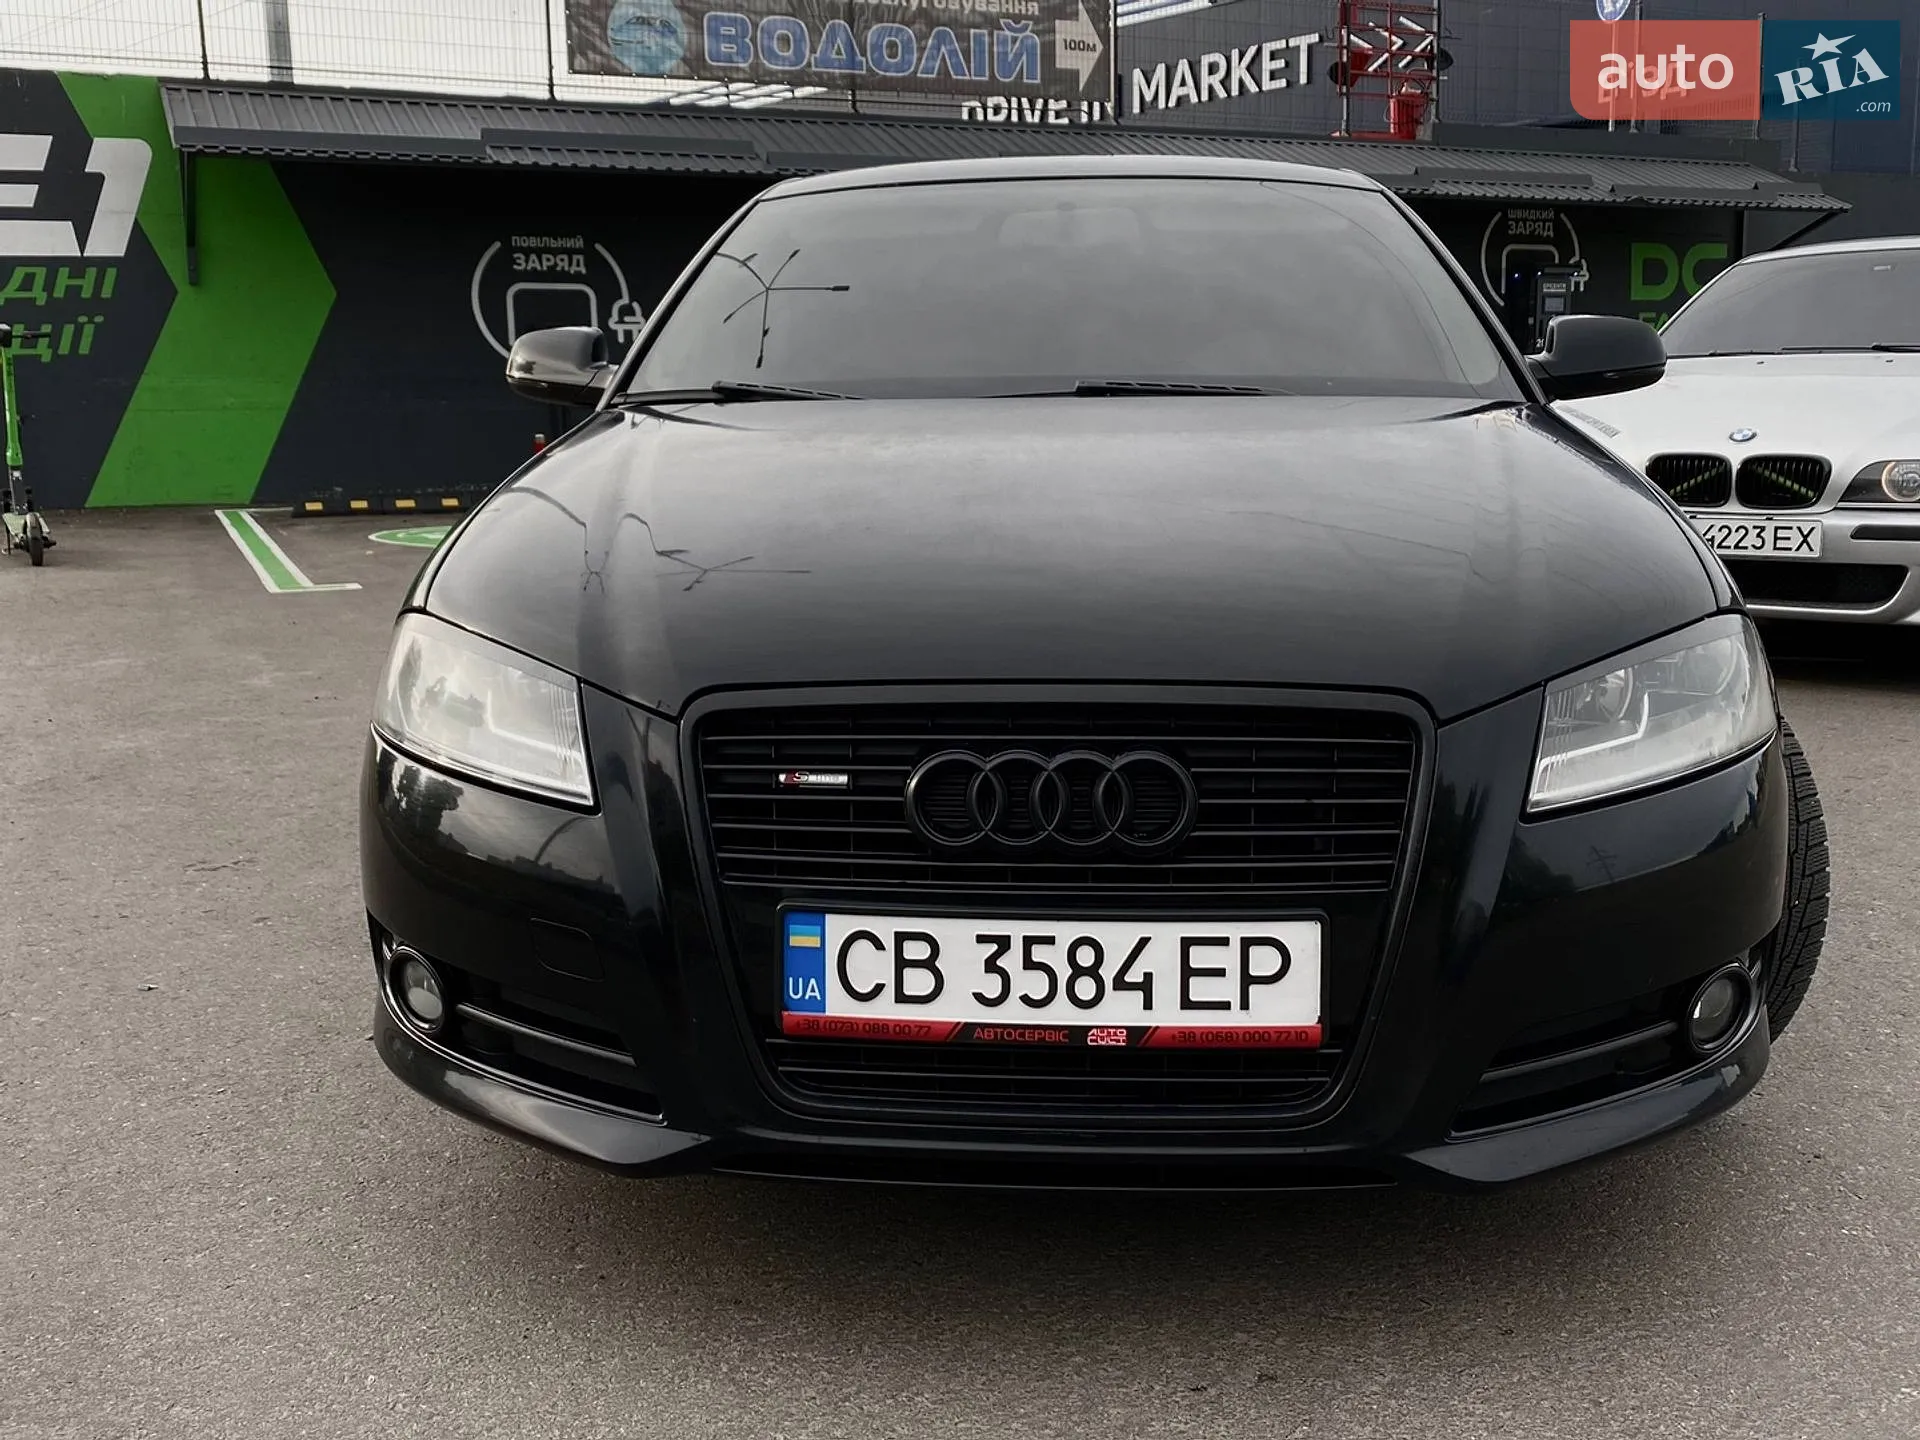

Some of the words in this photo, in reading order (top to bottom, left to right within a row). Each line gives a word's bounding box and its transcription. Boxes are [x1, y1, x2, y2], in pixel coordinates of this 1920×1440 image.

[703, 12, 1041, 84] ВОДОЛІЙ
[1132, 32, 1320, 114] MARKET
[1507, 219, 1555, 238] ЗАРЯД
[511, 235, 584, 249] ПОВІЛЬНИЙ
[512, 252, 587, 275] ЗАРЯД
[1703, 524, 1766, 551] 4223
[1772, 526, 1816, 552] EX
[836, 929, 945, 1005] CB
[971, 934, 1154, 1010] 3584
[1179, 935, 1293, 1011] EP
[788, 976, 822, 1001] UA
[973, 1027, 1070, 1042] АВТОСЕРВІС
